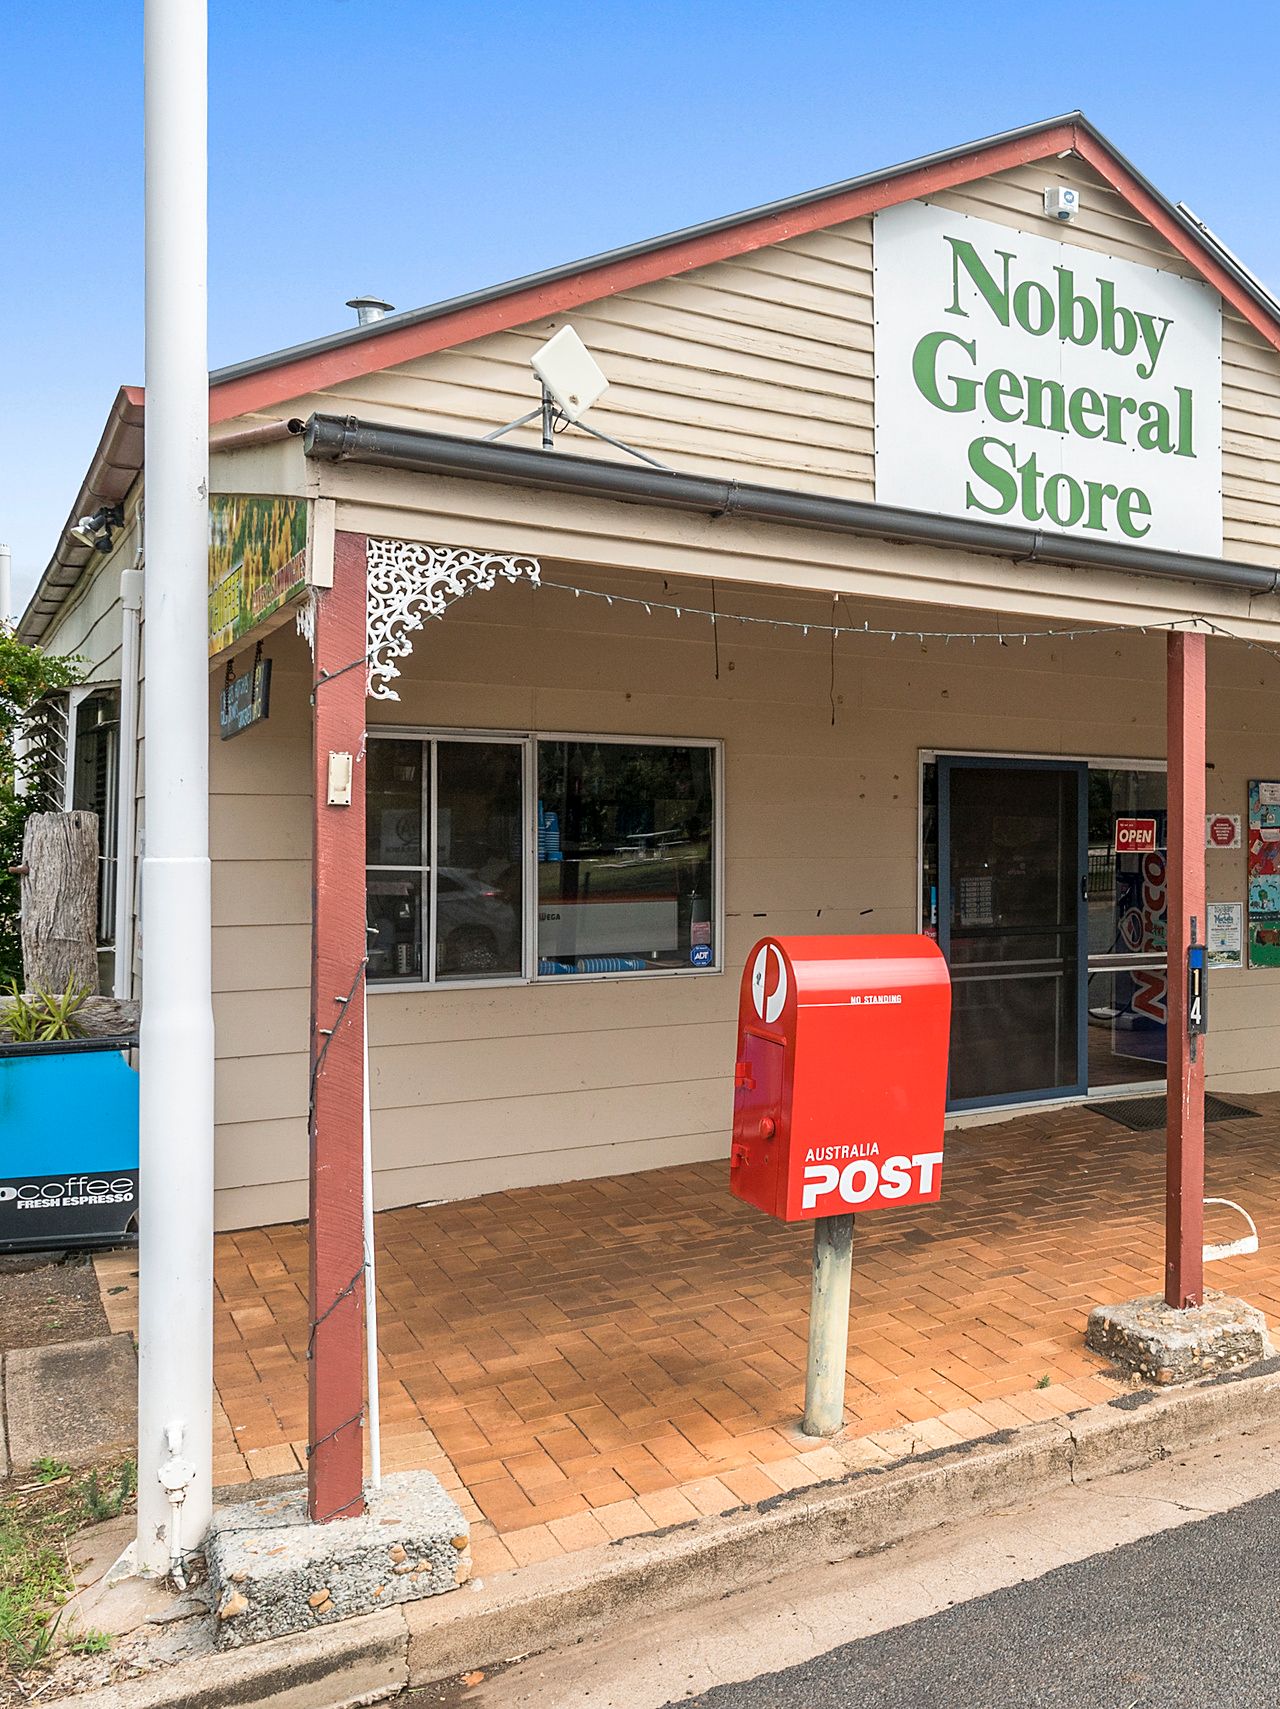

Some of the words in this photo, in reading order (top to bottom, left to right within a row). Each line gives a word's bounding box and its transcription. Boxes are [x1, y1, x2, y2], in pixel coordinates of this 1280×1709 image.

[943, 235, 1174, 380] Nobby
[912, 331, 1197, 458] General
[966, 436, 1153, 538] Store
[1119, 829, 1153, 843] OPEN
[694, 951, 709, 960] ADT
[850, 995, 862, 1005] NO
[864, 994, 902, 1004] STANDING
[805, 1142, 880, 1162] AUSTRALIA
[802, 1151, 943, 1209] POST
[17, 1197, 60, 1210] FRESH
[62, 1192, 134, 1207] ESPRESSO
